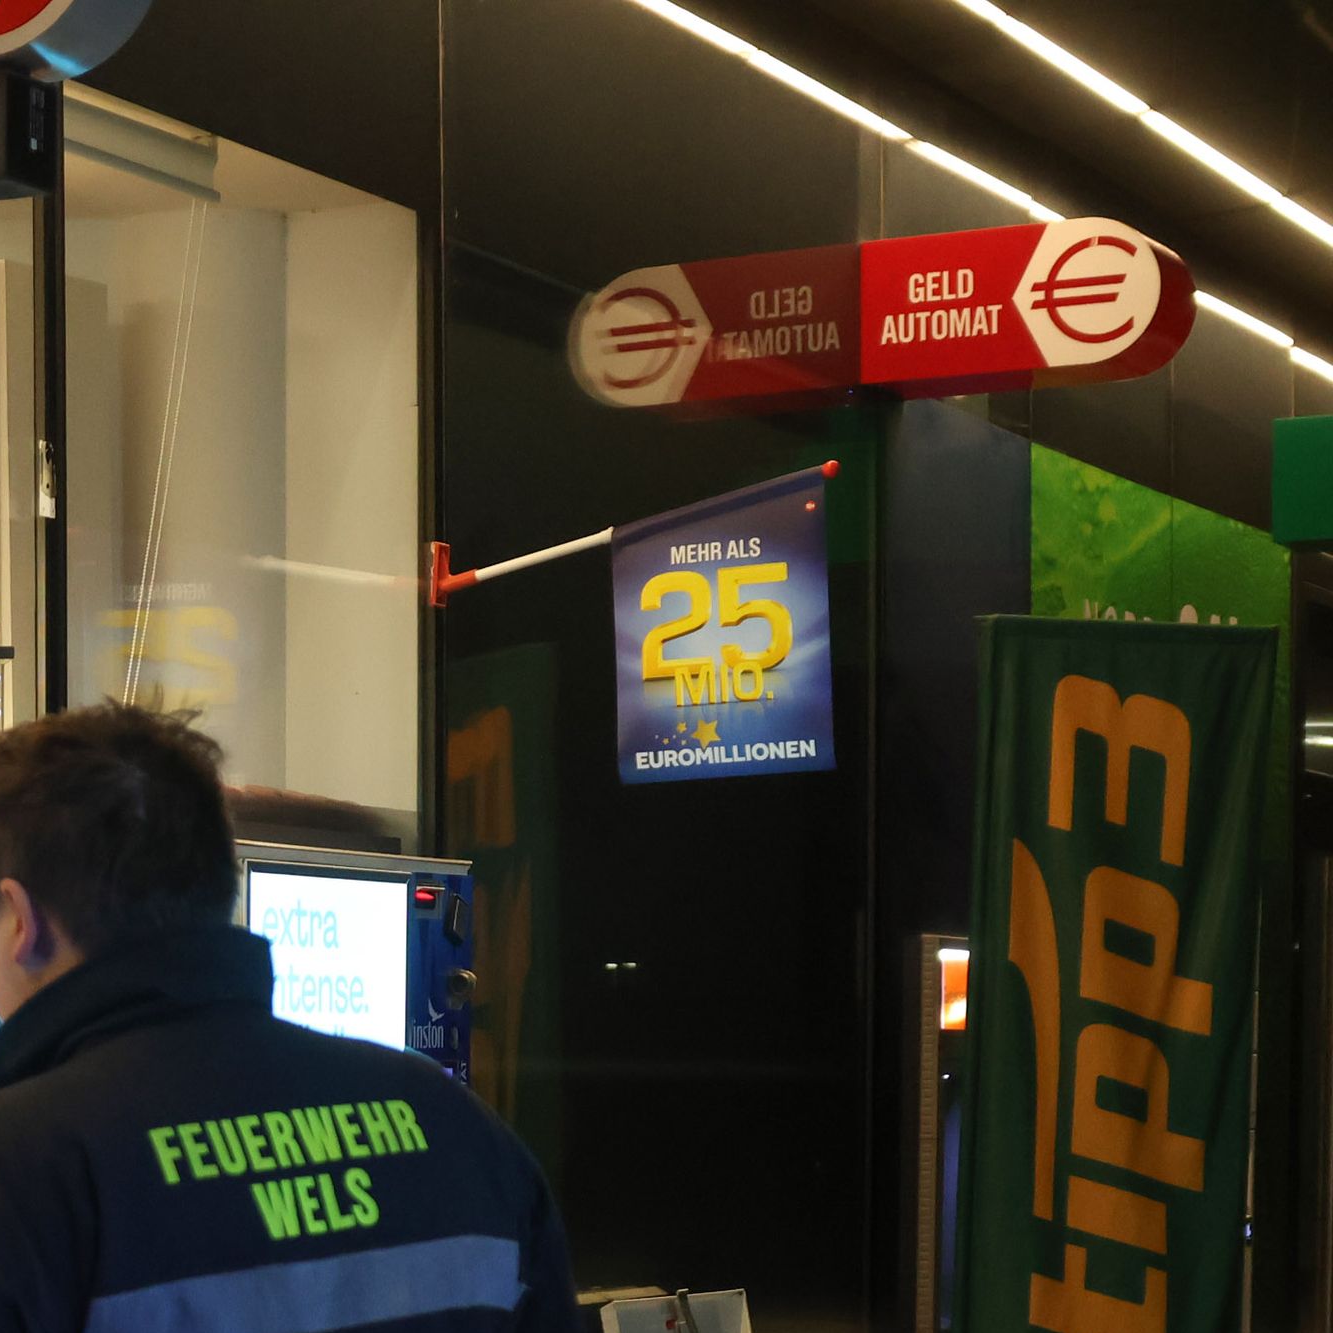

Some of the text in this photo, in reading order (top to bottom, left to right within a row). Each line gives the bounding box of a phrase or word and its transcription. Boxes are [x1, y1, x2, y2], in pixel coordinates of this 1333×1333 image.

[908, 269, 975, 303] GELD
[880, 303, 1003, 346] AUTOMAT
[670, 537, 761, 564] MEHR ALS
[639, 560, 794, 682] 25
[635, 738, 817, 771] EUROMILLIONEN
[262, 899, 340, 949] extra
[274, 964, 370, 1015] ntense.
[148, 1098, 430, 1186] FEUERWEHR
[251, 1169, 381, 1241] WELS
